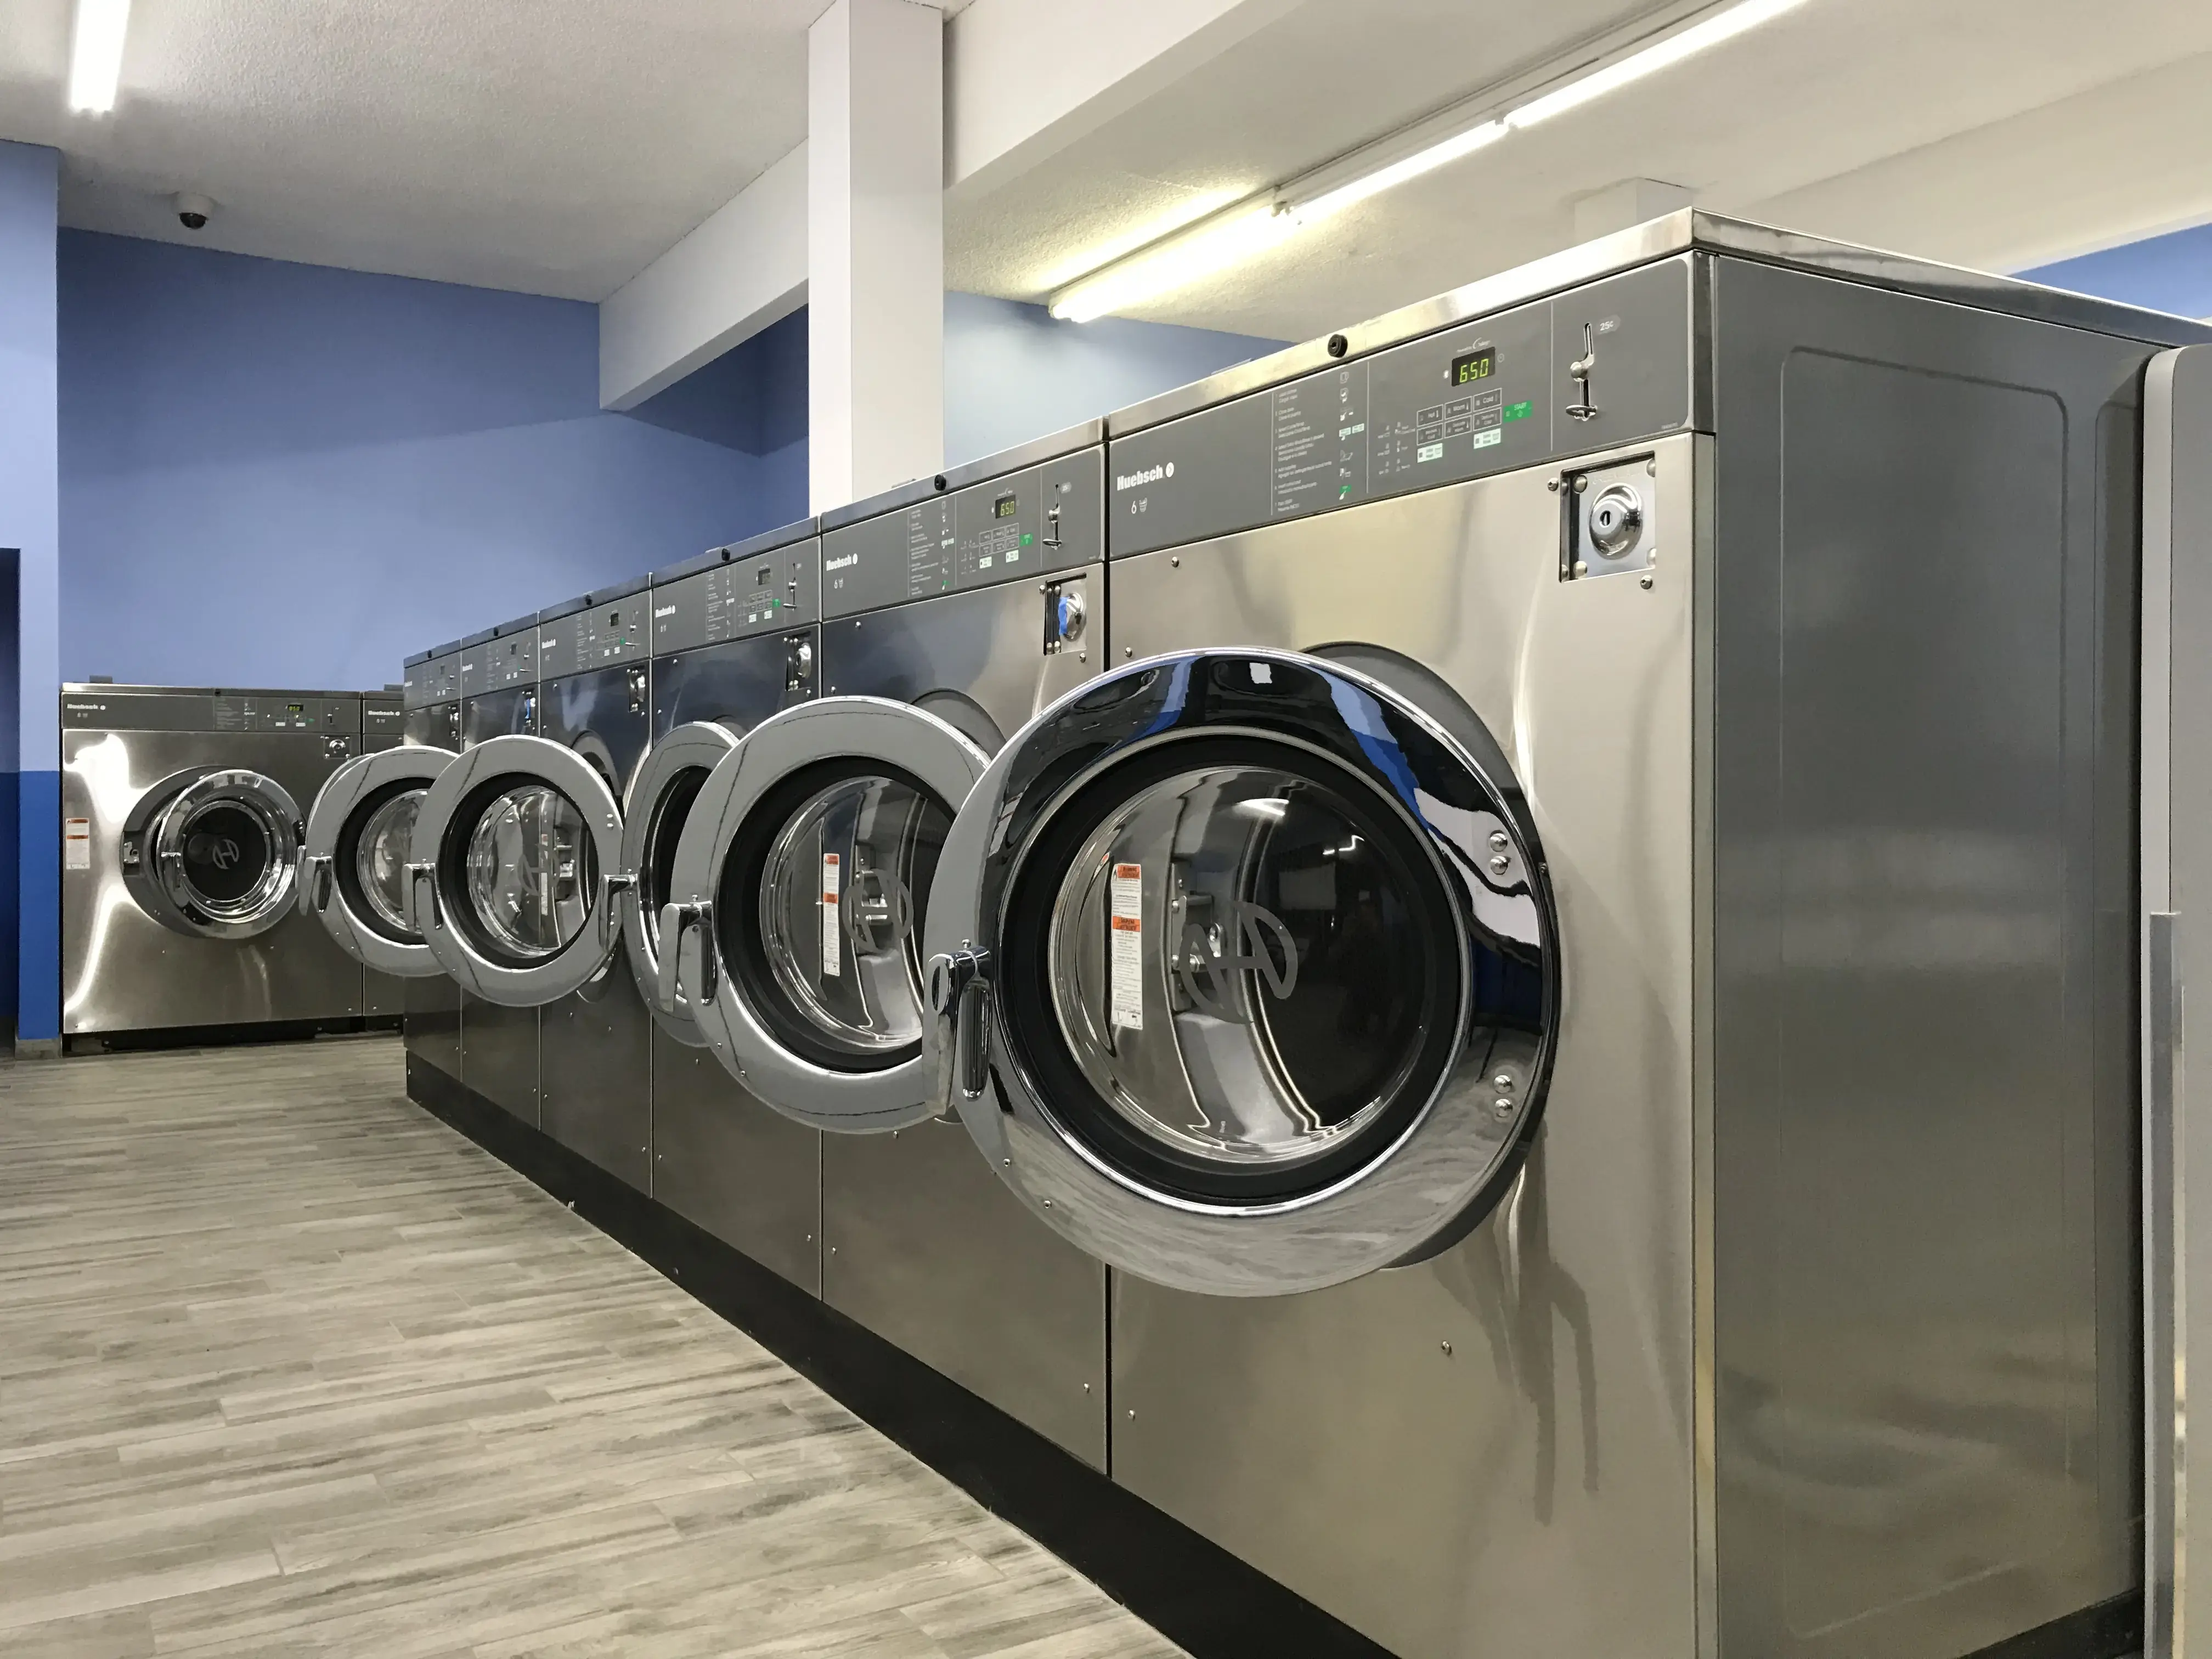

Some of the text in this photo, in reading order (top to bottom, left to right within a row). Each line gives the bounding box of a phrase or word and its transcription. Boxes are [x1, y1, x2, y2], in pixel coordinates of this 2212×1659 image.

[1459, 358, 1489, 383] 650
[1116, 465, 1163, 491] Huebsch
[1000, 500, 1015, 516] 650
[1131, 500, 1137, 515] 6
